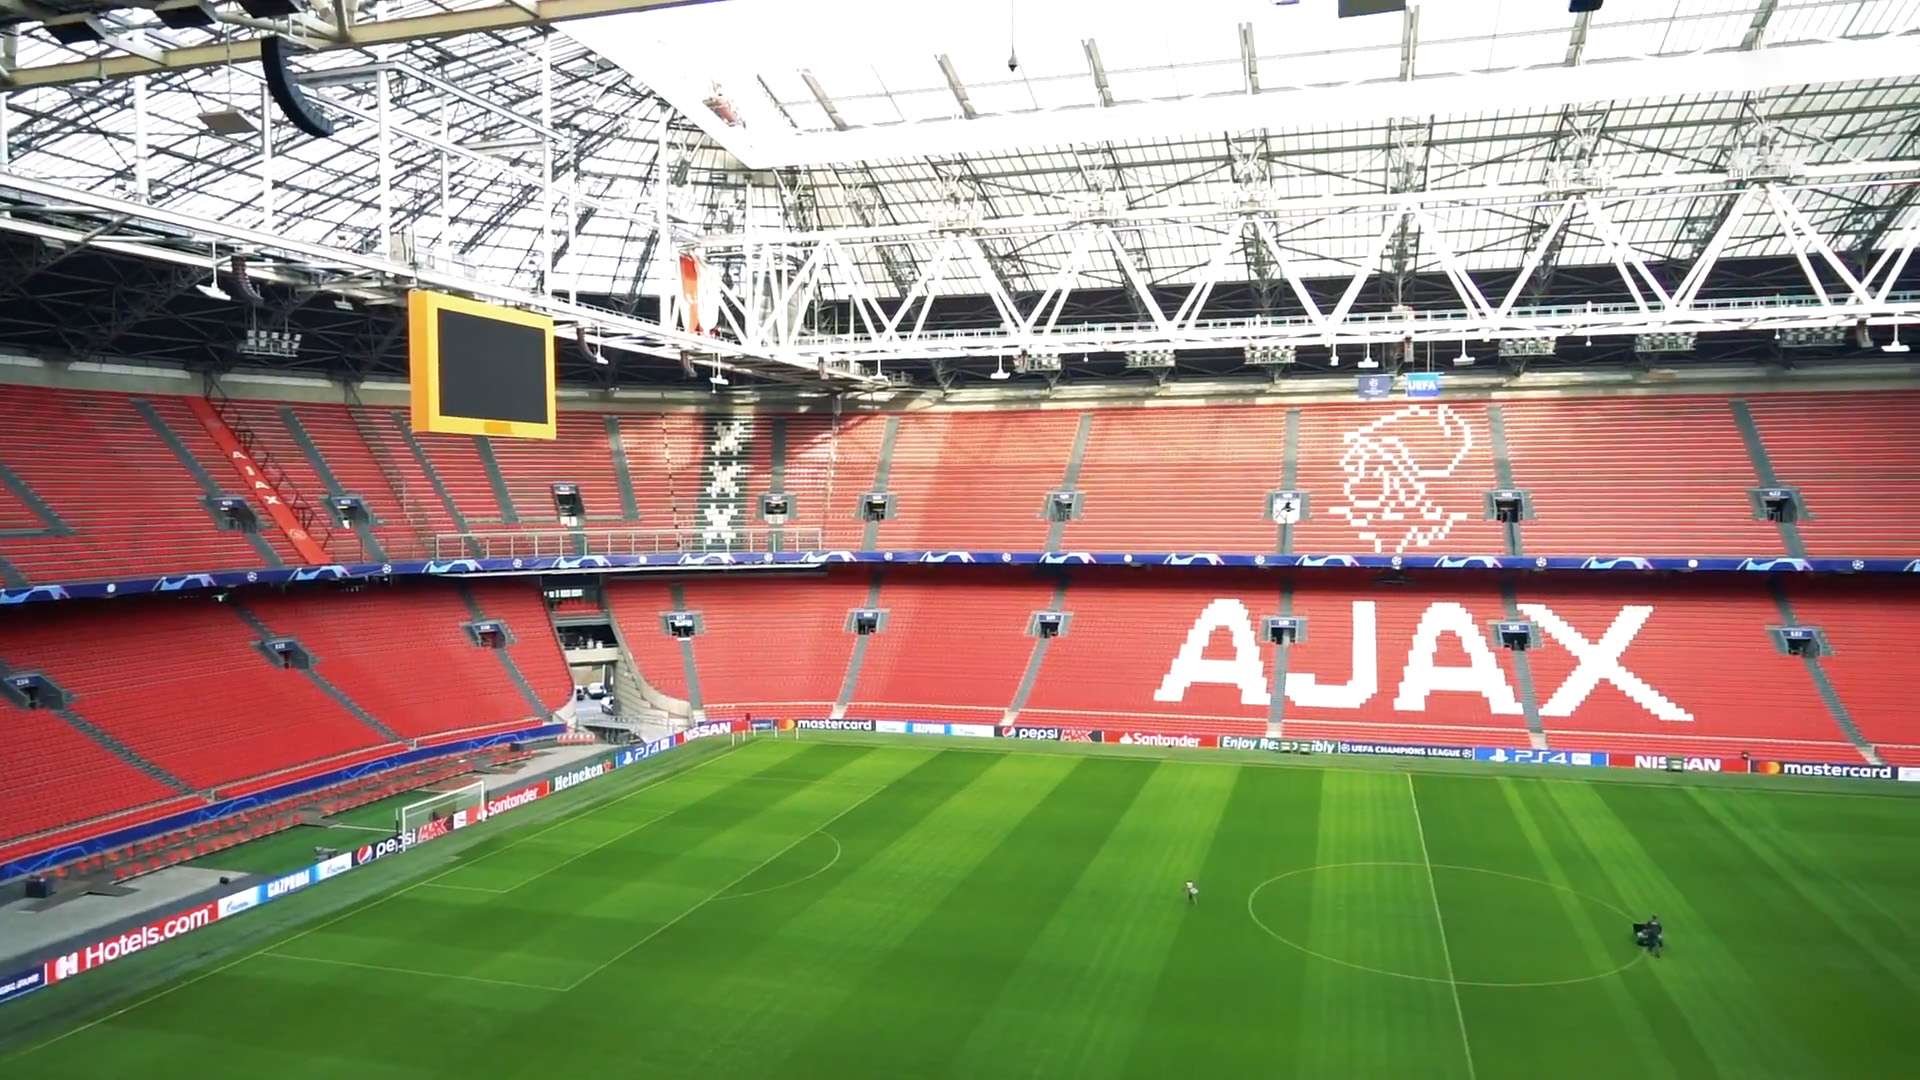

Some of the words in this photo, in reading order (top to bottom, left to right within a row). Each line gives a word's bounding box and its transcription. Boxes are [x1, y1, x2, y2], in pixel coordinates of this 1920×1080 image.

[1408, 380, 1436, 391] UEFA
[1154, 598, 1694, 721] AJAX
[683, 721, 731, 742] NISSAN
[797, 719, 872, 731] mastercard
[1019, 728, 1058, 740] pepsi
[1133, 732, 1201, 747] Santander
[635, 742, 659, 761] PS4
[1222, 736, 1257, 750] Enjoy
[1259, 738, 1335, 754] Reibly
[1351, 744, 1374, 753] UEFA
[1375, 745, 1426, 756] CHAMPIONS
[1427, 747, 1461, 758] LEAGUE
[1514, 750, 1567, 764] PS4
[1634, 755, 1721, 771] NISAN
[554, 762, 604, 792] Heineken
[1784, 761, 1892, 778] mastercard
[488, 786, 539, 816] Santander
[86, 906, 210, 968] Hotels.com
